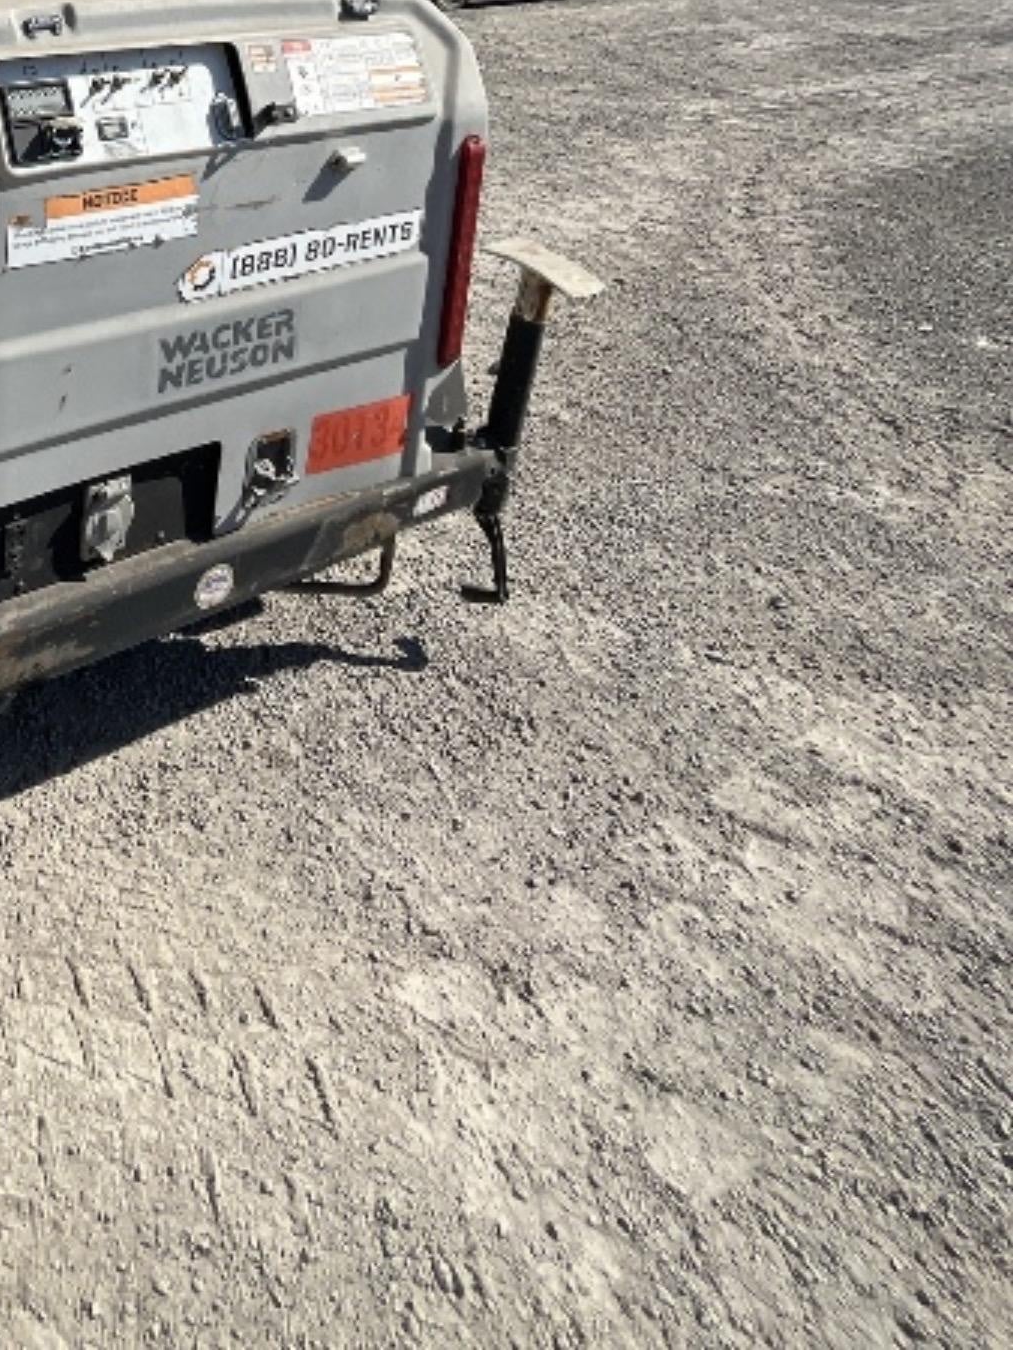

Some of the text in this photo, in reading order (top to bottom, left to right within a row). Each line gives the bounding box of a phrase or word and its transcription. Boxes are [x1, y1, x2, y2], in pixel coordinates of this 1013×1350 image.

[230, 221, 415, 279] (888) 80-RENTS
[158, 308, 295, 363] WACKER
[157, 336, 295, 394] NEUSON
